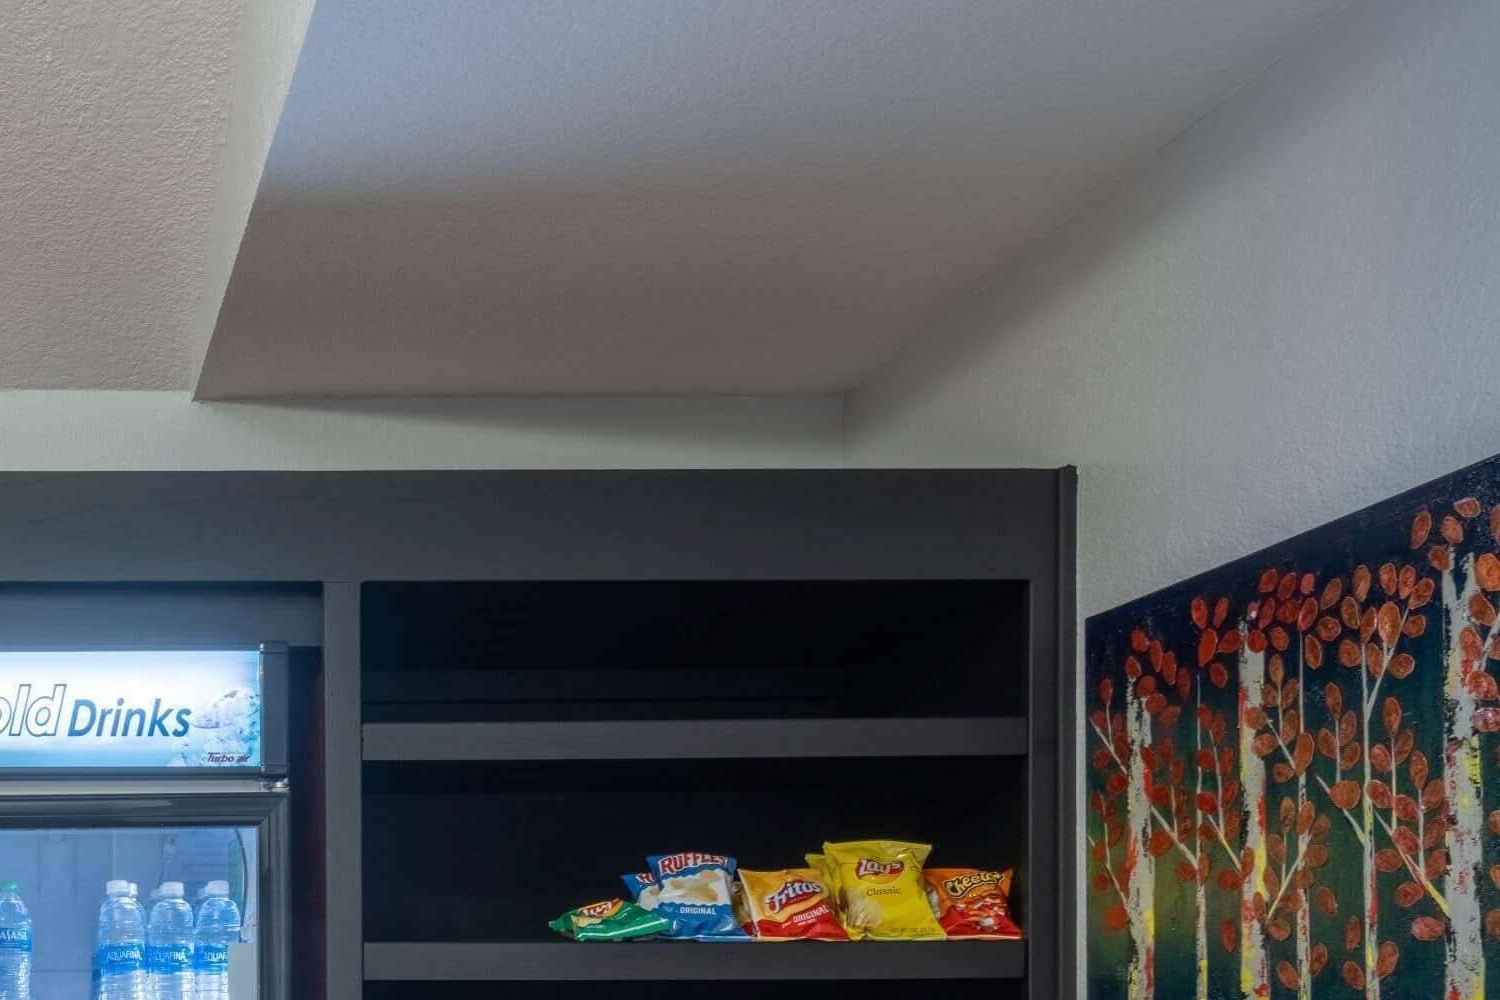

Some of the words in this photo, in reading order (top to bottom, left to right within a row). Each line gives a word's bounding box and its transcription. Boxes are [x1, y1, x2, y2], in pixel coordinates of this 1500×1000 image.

[67, 698, 192, 737] Drinks
[658, 852, 729, 874] RUFFLES
[764, 879, 822, 913] Fritos
[679, 906, 717, 915] ORIGINAL
